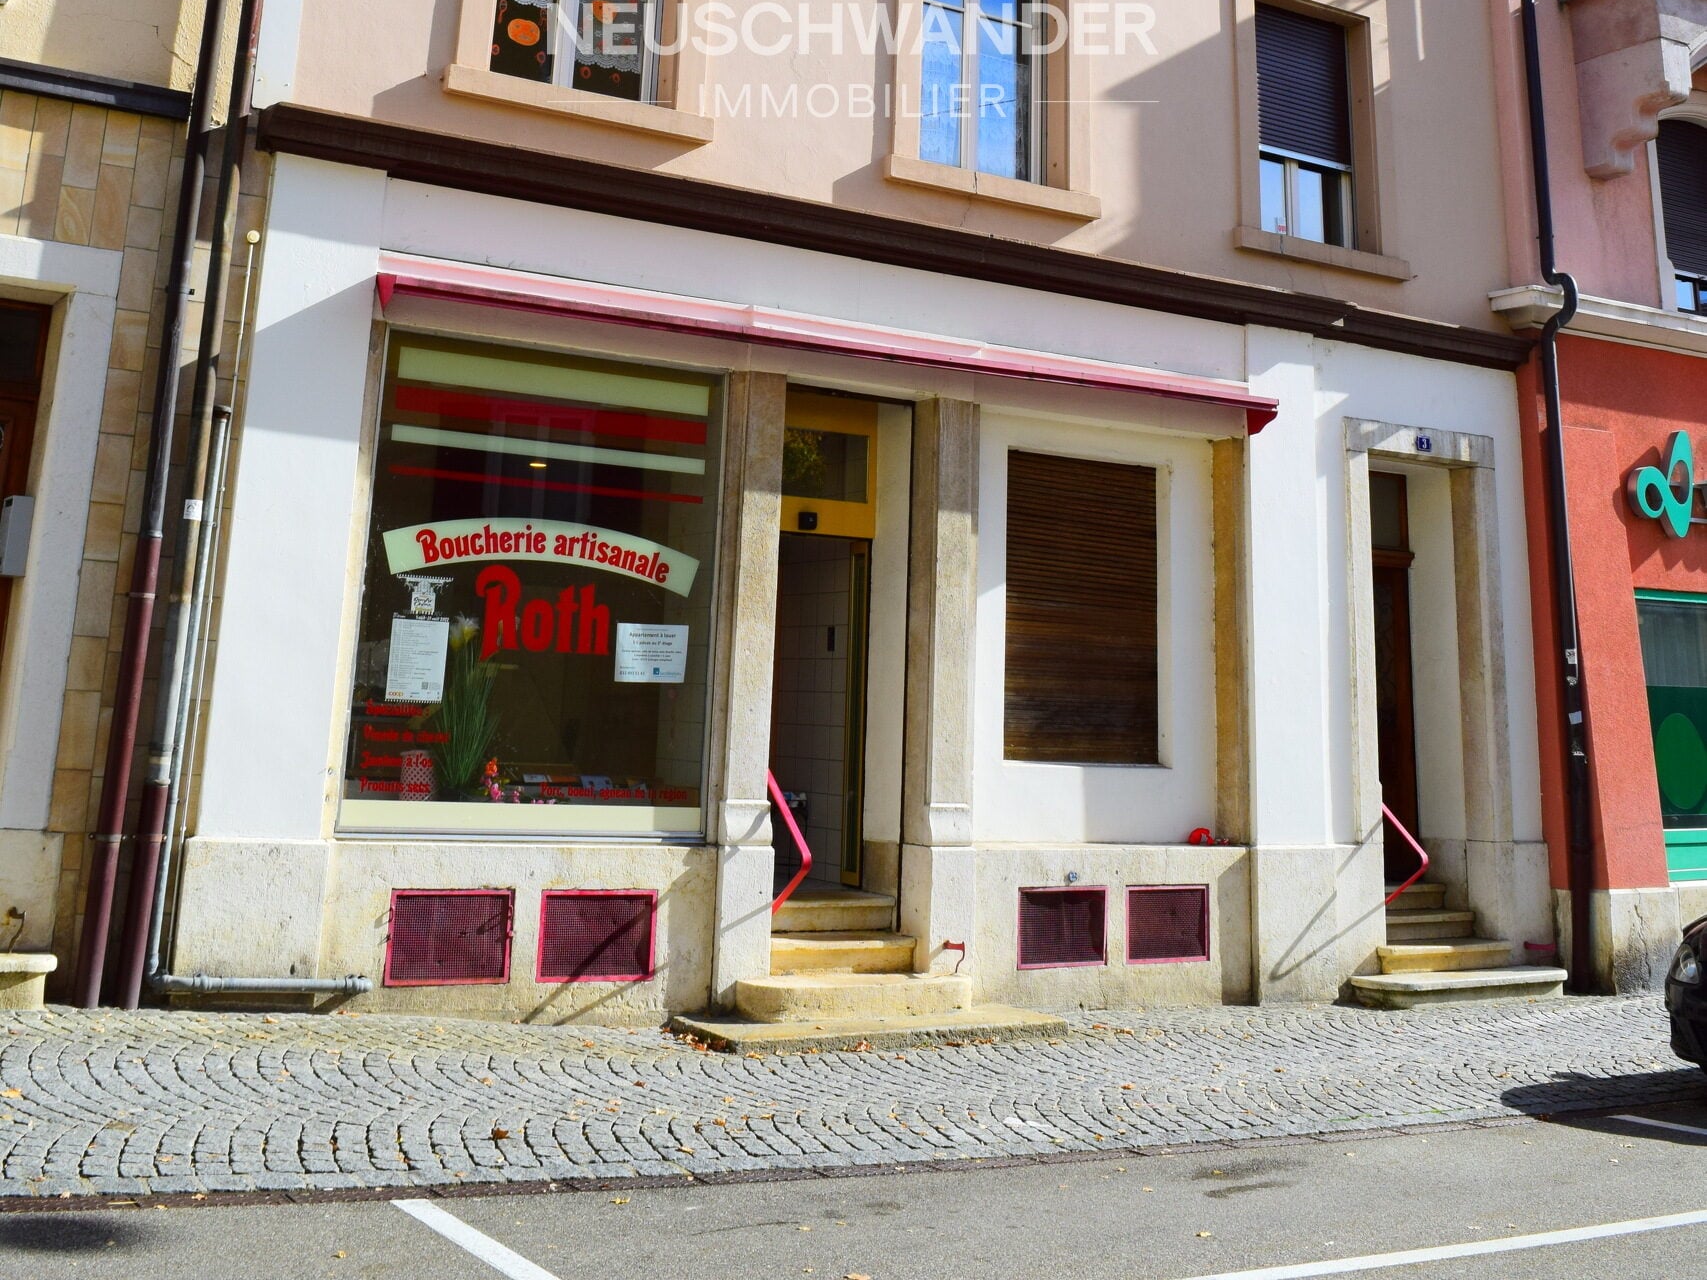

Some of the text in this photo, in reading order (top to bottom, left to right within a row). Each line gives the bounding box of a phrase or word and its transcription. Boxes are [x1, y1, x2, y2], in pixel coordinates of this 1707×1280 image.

[416, 524, 670, 583] Boucherie artisanale
[475, 564, 610, 662] Roth
[360, 775, 431, 793] Produits secs
